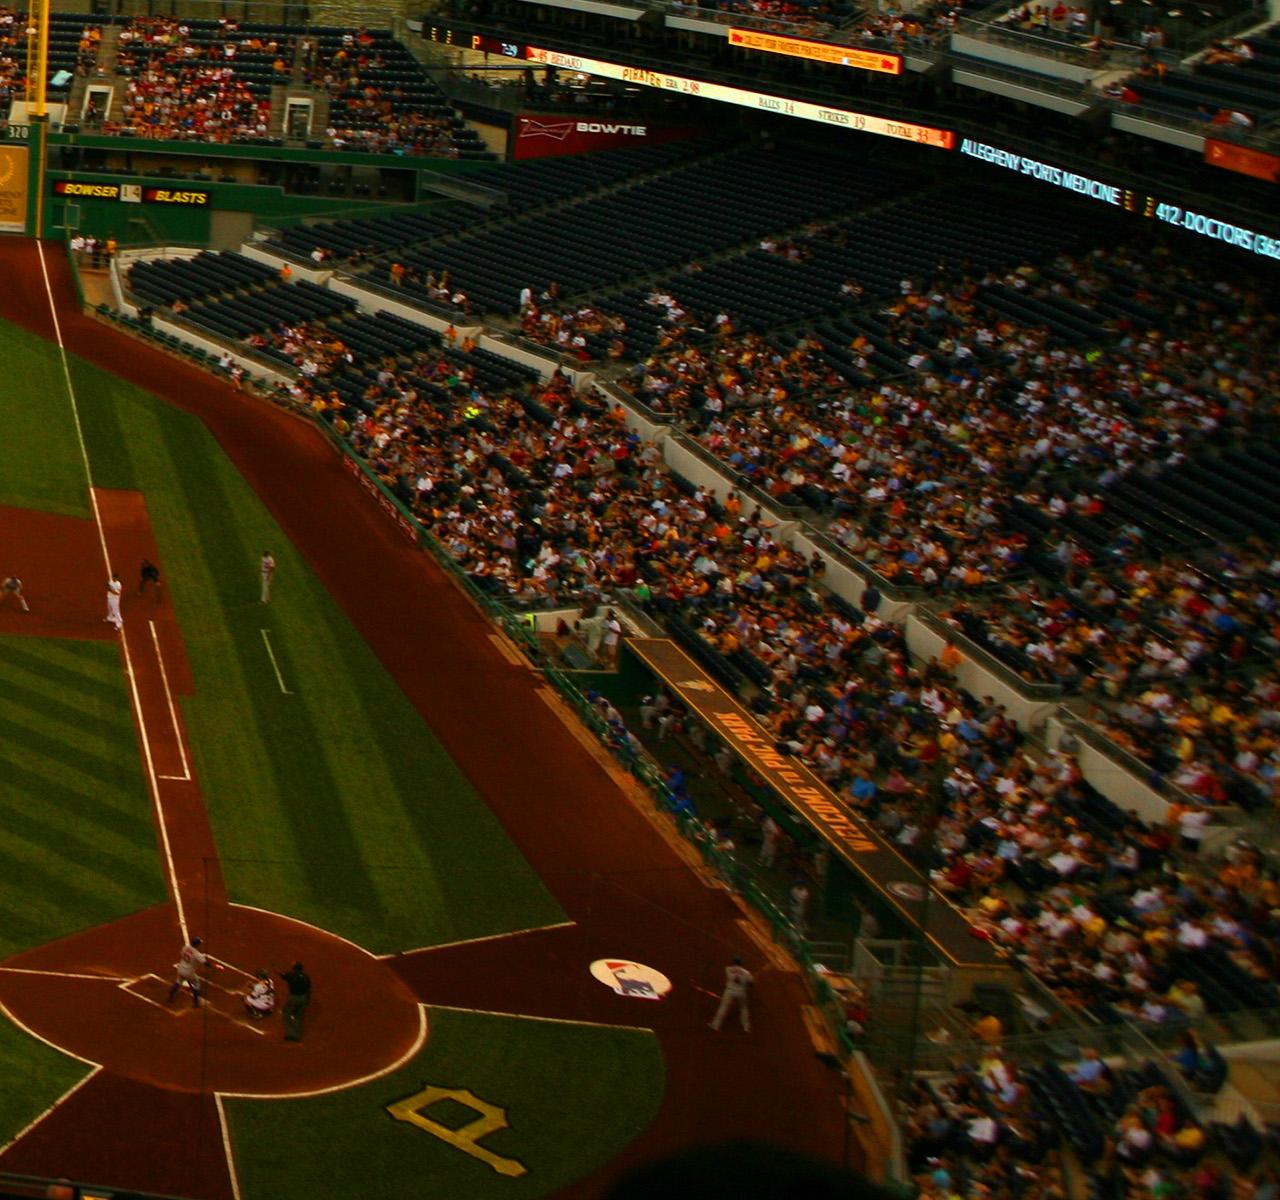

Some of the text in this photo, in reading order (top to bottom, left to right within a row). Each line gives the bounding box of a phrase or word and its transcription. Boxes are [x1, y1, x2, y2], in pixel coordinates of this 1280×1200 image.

[817, 109, 866, 130] STRIKES 19
[8, 126, 29, 139] 320
[576, 122, 647, 136] BOWTIE
[886, 123, 912, 138] TOTAL
[960, 138, 1122, 206] ALLEGHENY SPORTS MEDICINE
[64, 182, 119, 198] BOWSER
[155, 190, 207, 205] BLASTS
[714, 712, 764, 743] PARK
[747, 742, 792, 770] PNC
[789, 786, 879, 853] WELCOME
